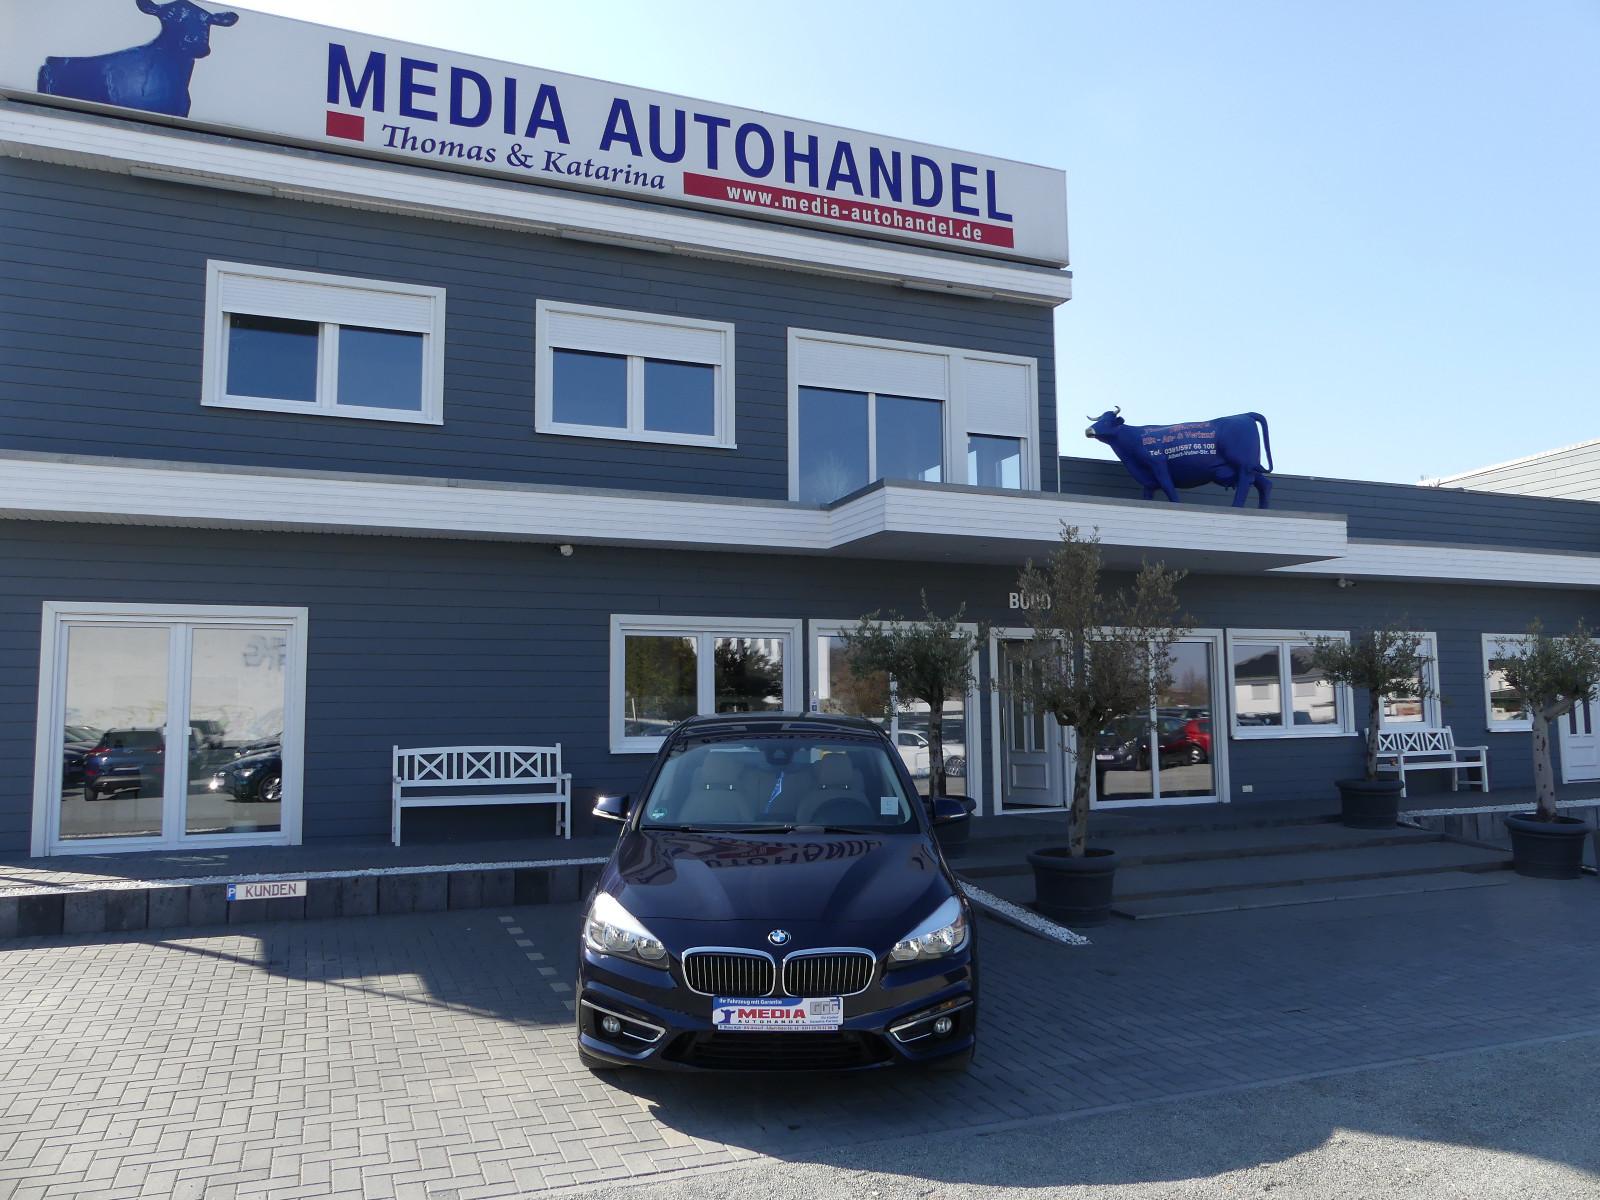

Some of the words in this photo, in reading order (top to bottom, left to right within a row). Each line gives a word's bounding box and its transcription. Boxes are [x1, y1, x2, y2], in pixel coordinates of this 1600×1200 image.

[327, 42, 571, 145] MEDIA
[599, 97, 1013, 223] AUTOHANDEL
[382, 124, 497, 163] Thomas
[506, 143, 534, 168] &
[541, 150, 666, 190] Katarina
[726, 185, 983, 242] www.media-autohandel.de
[229, 888, 236, 897] P
[245, 883, 297, 897] KUNDEN
[737, 1008, 806, 1019] MEDIA
